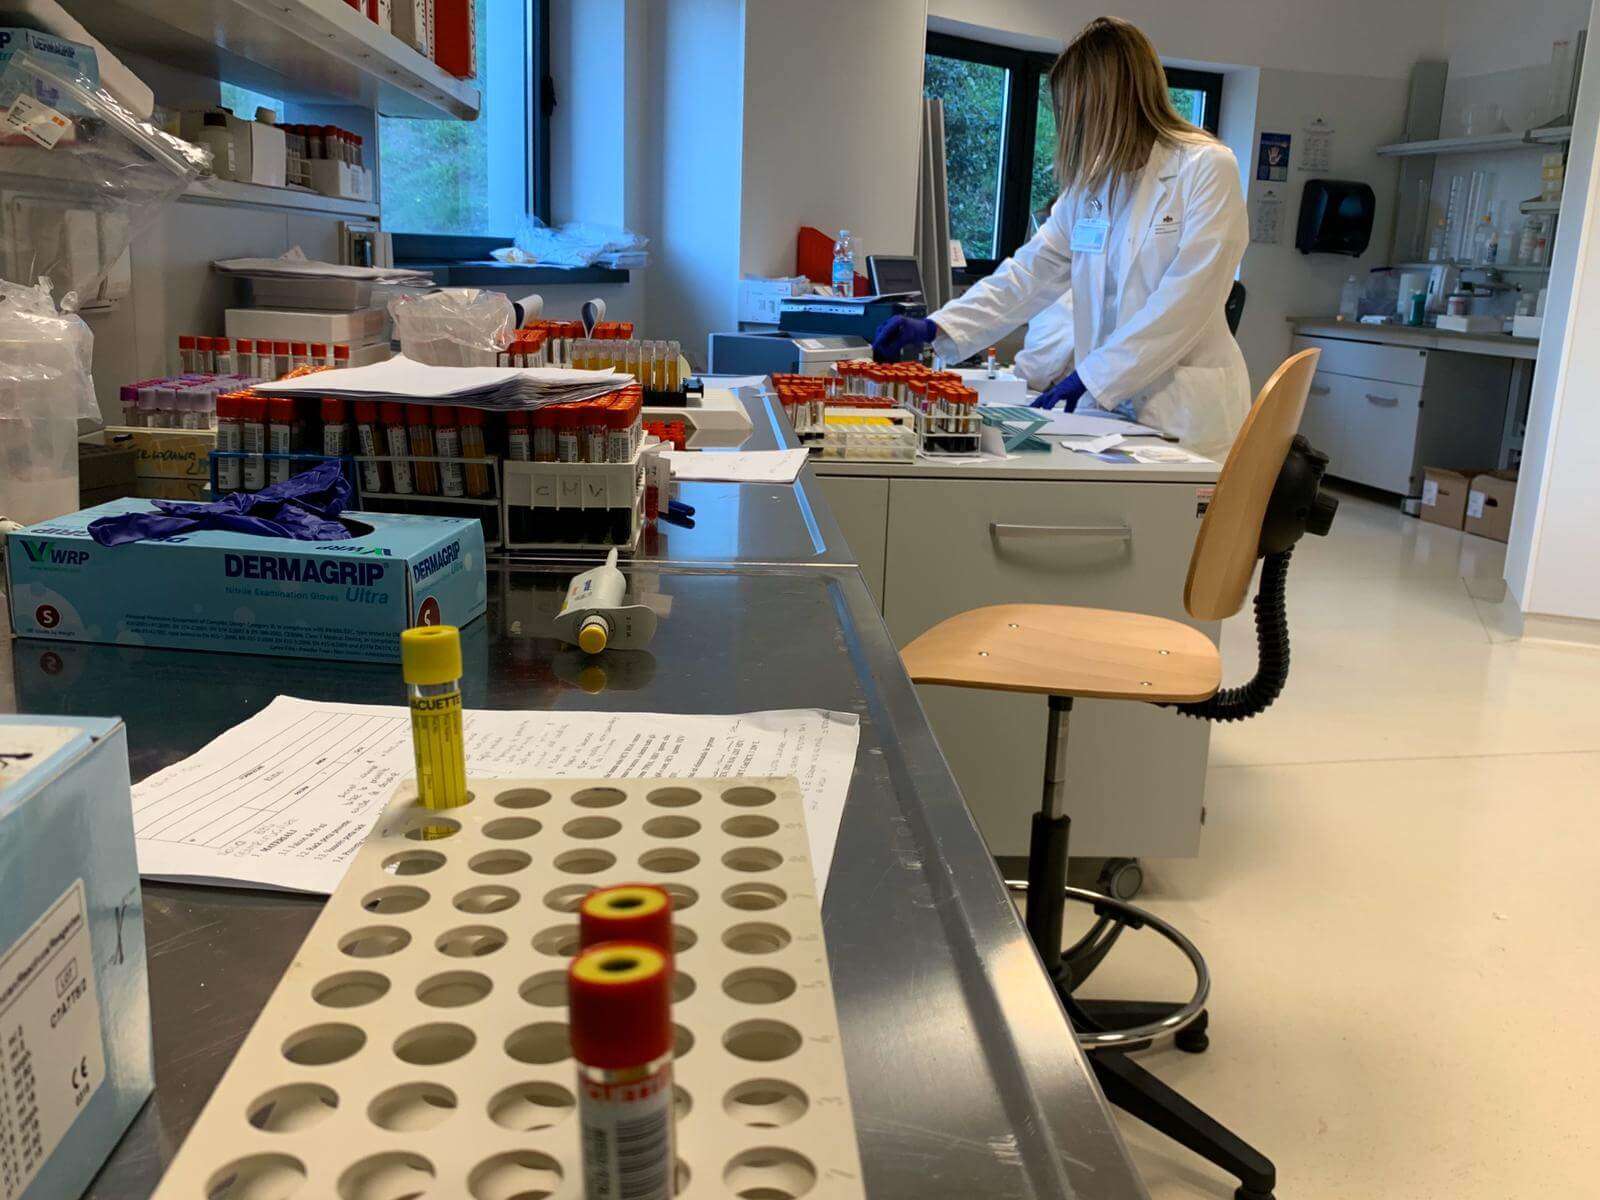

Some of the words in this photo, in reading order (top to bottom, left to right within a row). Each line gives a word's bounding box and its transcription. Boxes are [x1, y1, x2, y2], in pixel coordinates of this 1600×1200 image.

[51, 549, 90, 565] WRP
[412, 541, 461, 584] DERMAGRIP
[224, 553, 385, 587] DERMAGRIP
[254, 588, 309, 600] Examination
[345, 586, 390, 605] Ultra
[43, 610, 54, 624] S
[407, 695, 461, 711] ACUETTE
